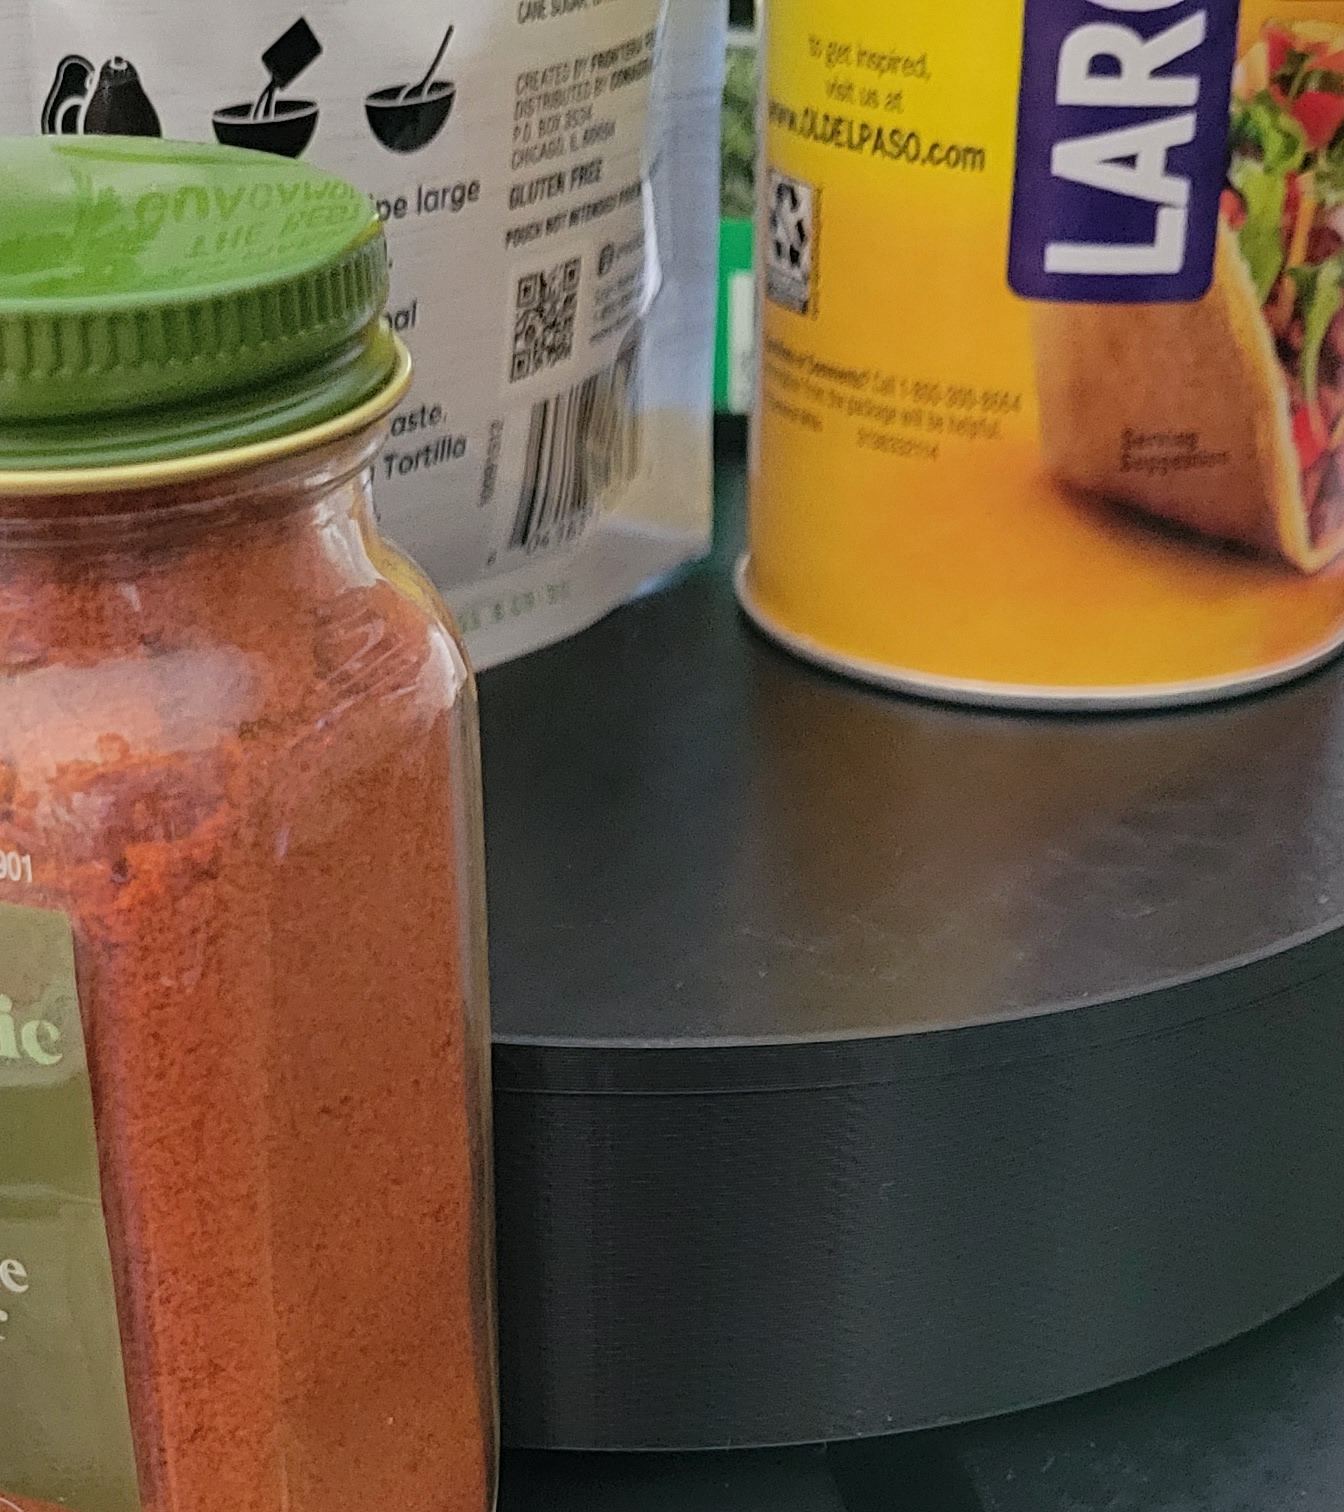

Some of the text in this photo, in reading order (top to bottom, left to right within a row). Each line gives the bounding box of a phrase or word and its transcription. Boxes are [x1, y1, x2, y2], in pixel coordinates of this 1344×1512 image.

[1043, 0, 1206, 276] LAR
[416, 180, 482, 216] large
[509, 171, 567, 210] GLUTEN
[383, 434, 467, 480] Tortilla
